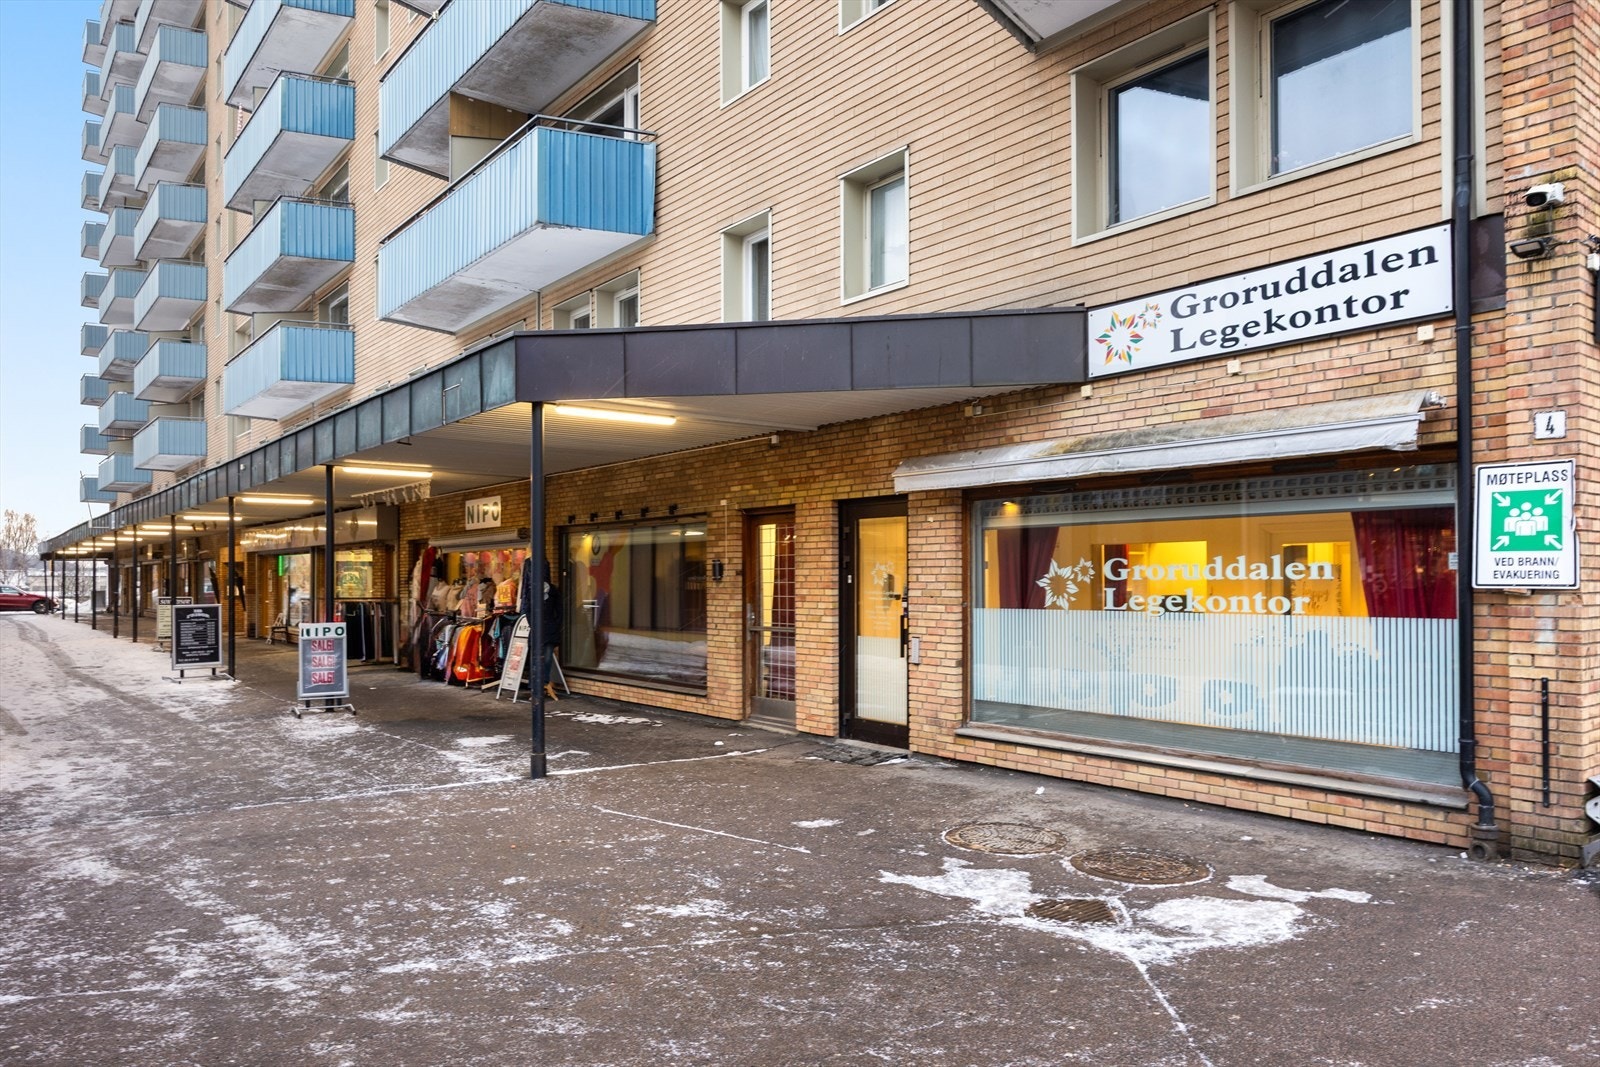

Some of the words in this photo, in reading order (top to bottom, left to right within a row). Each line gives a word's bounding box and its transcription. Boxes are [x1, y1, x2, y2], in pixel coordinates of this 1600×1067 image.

[1170, 243, 1439, 320] Groruddalen
[1170, 286, 1410, 352] Legekontor
[1545, 415, 1555, 434] 4
[1486, 469, 1569, 486] MØTEPLASS
[467, 501, 499, 524] NIPO
[1103, 554, 1334, 581] Groruddalen
[1494, 557, 1514, 567] VED
[1518, 556, 1559, 567] BRANN/
[1493, 570, 1560, 580] EVAKUERING
[1103, 587, 1311, 617] Legekontor
